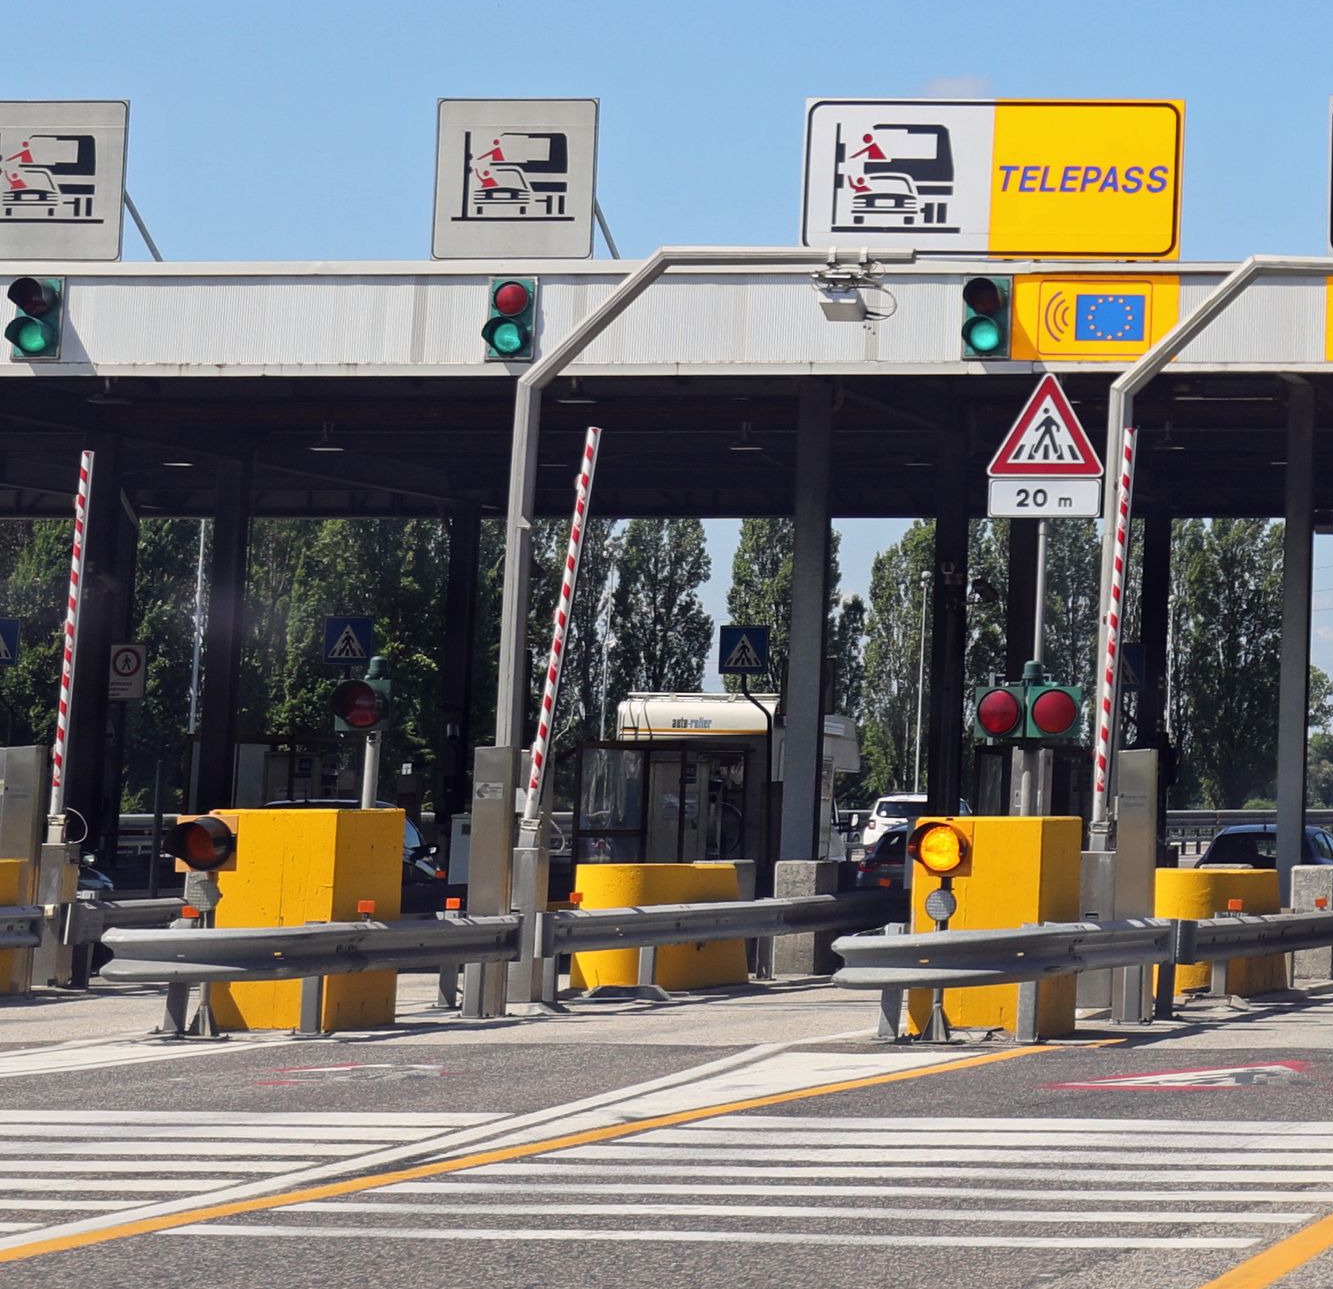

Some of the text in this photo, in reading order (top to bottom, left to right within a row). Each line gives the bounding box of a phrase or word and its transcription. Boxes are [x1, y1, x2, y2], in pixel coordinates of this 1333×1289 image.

[998, 165, 1168, 193] TELEPASS
[1015, 488, 1073, 508] 20 m
